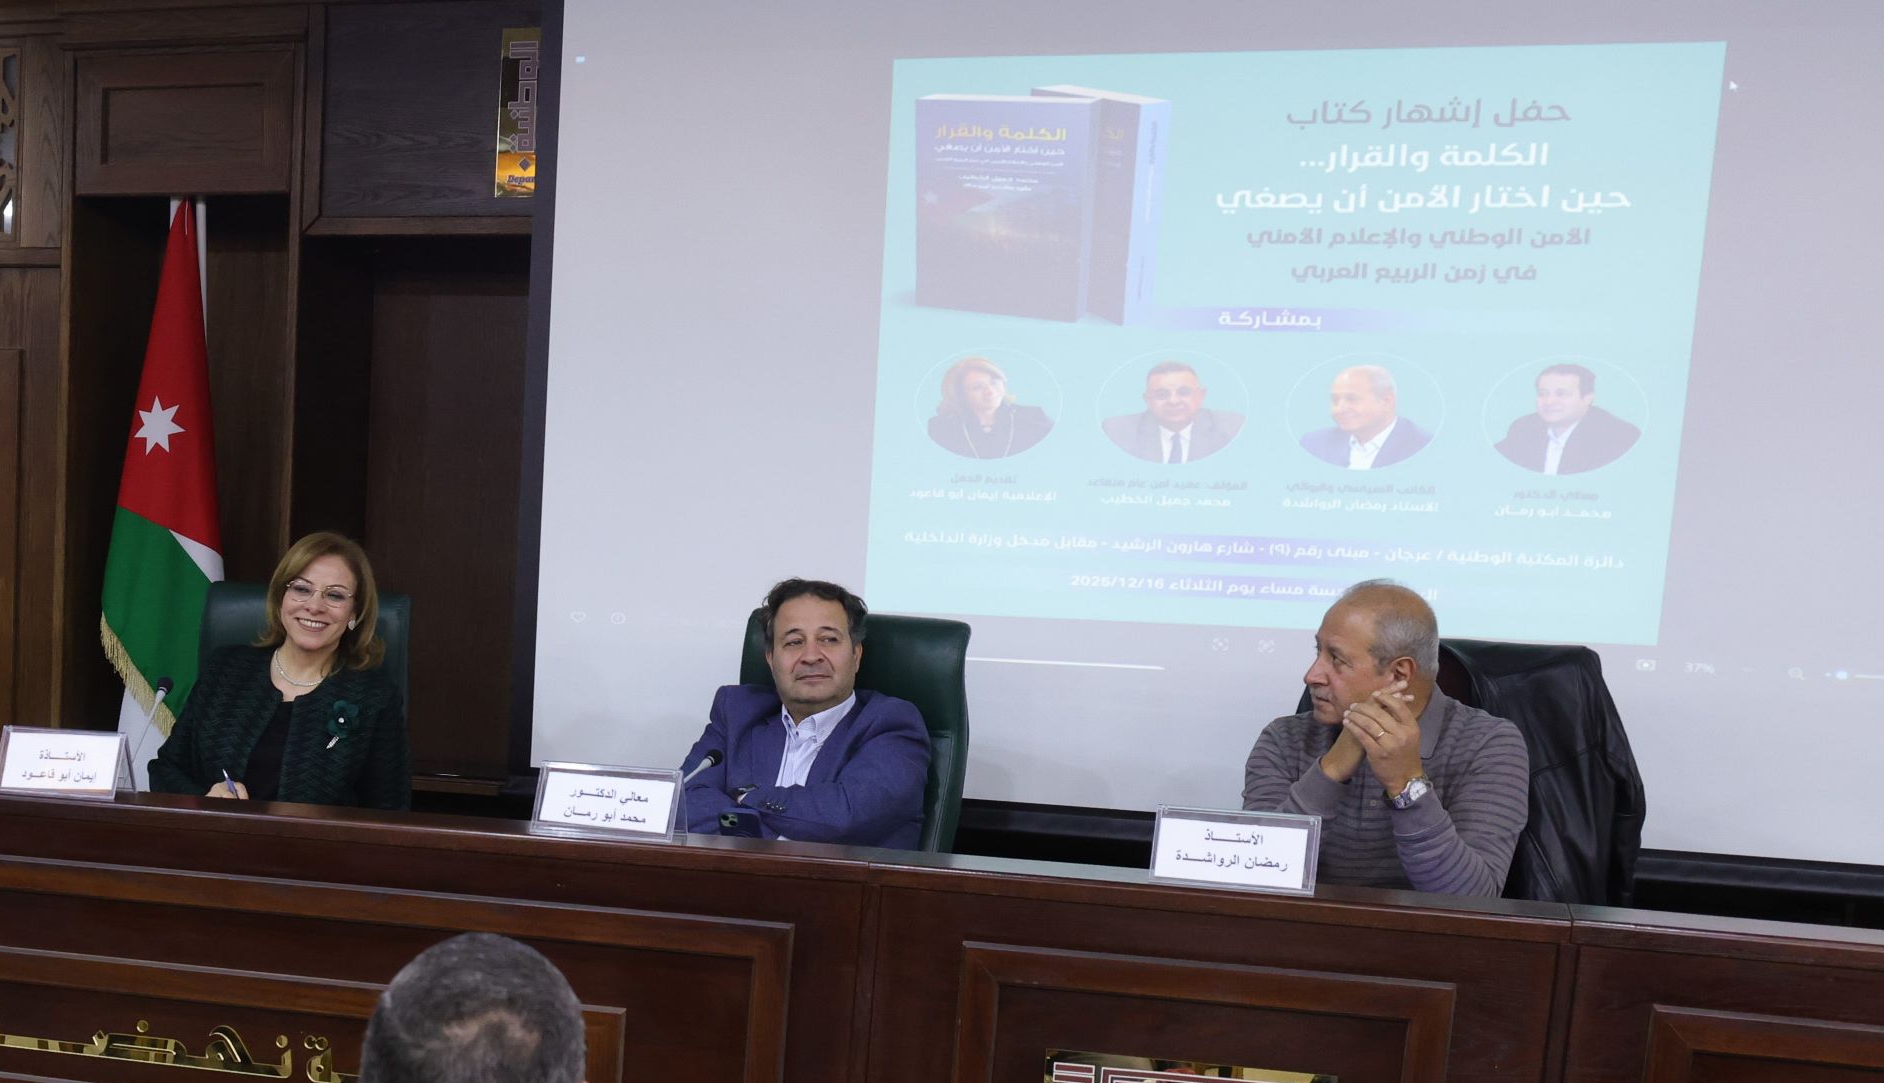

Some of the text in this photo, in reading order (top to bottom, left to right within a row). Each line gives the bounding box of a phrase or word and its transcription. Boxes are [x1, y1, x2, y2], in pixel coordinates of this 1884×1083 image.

[1287, 97, 1572, 130] حفل إشهار كتاب
[1439, 141, 1549, 167] الكلمة
[1217, 184, 1632, 214] حين اختار الأمن أن يصغي
[1247, 226, 1592, 249] الأمن الوطني والإعلام الأمني
[1292, 261, 1537, 284] في زمن الربيع العربي
[1218, 309, 1322, 329] بمشاركة
[1563, 508, 1612, 519] محمد
[904, 530, 964, 545] الداخلية
[1006, 534, 1050, 548] مدخل
[1054, 535, 1098, 550] مقابل
[1111, 539, 1161, 552] الرشيد
[1166, 541, 1213, 555] هارون
[1217, 542, 1254, 556] شارع
[1294, 547, 1323, 560] رقم
[1447, 550, 1511, 566] الوطنية
[1516, 552, 1579, 567] المكتبة
[1070, 575, 1164, 589] 2025/12/16
[1226, 583, 1255, 595] يوم
[1260, 583, 1304, 596] مساء
[569, 788, 649, 804] معالي الدكتور
[563, 805, 598, 821] رمان
[620, 813, 646, 824] محمد
[1175, 849, 1288, 872] رمضان الرواشدة
